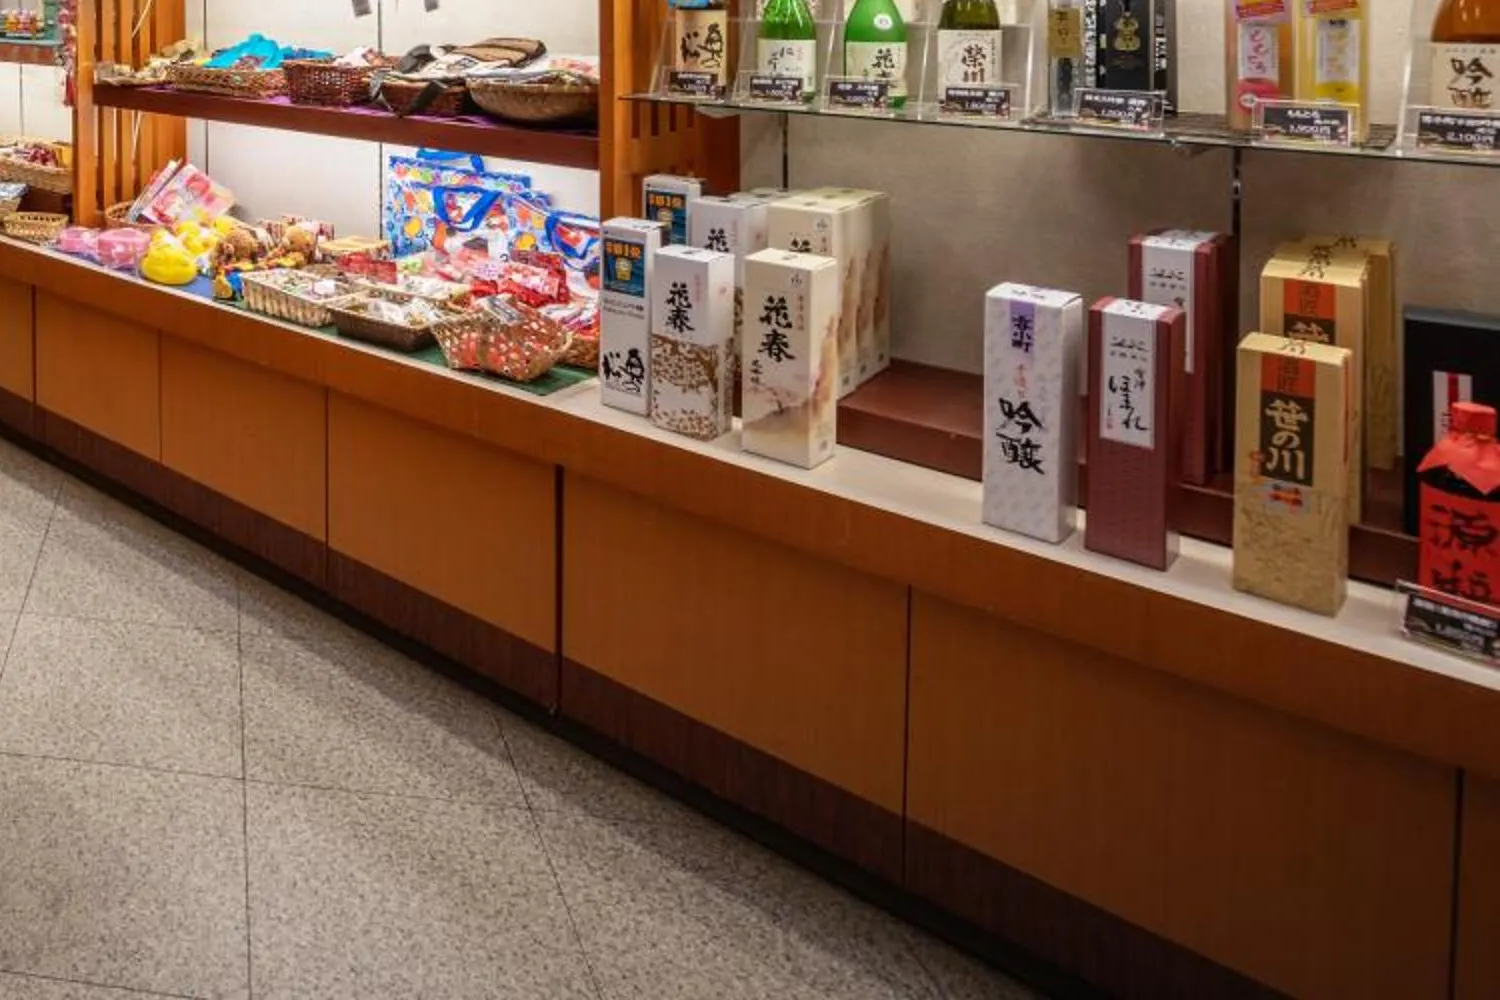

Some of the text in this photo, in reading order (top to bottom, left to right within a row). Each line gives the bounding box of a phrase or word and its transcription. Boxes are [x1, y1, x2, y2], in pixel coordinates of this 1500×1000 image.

[666, 281, 695, 333] 花春
[759, 295, 796, 363] 花春
[996, 397, 1045, 475] 吟醸
